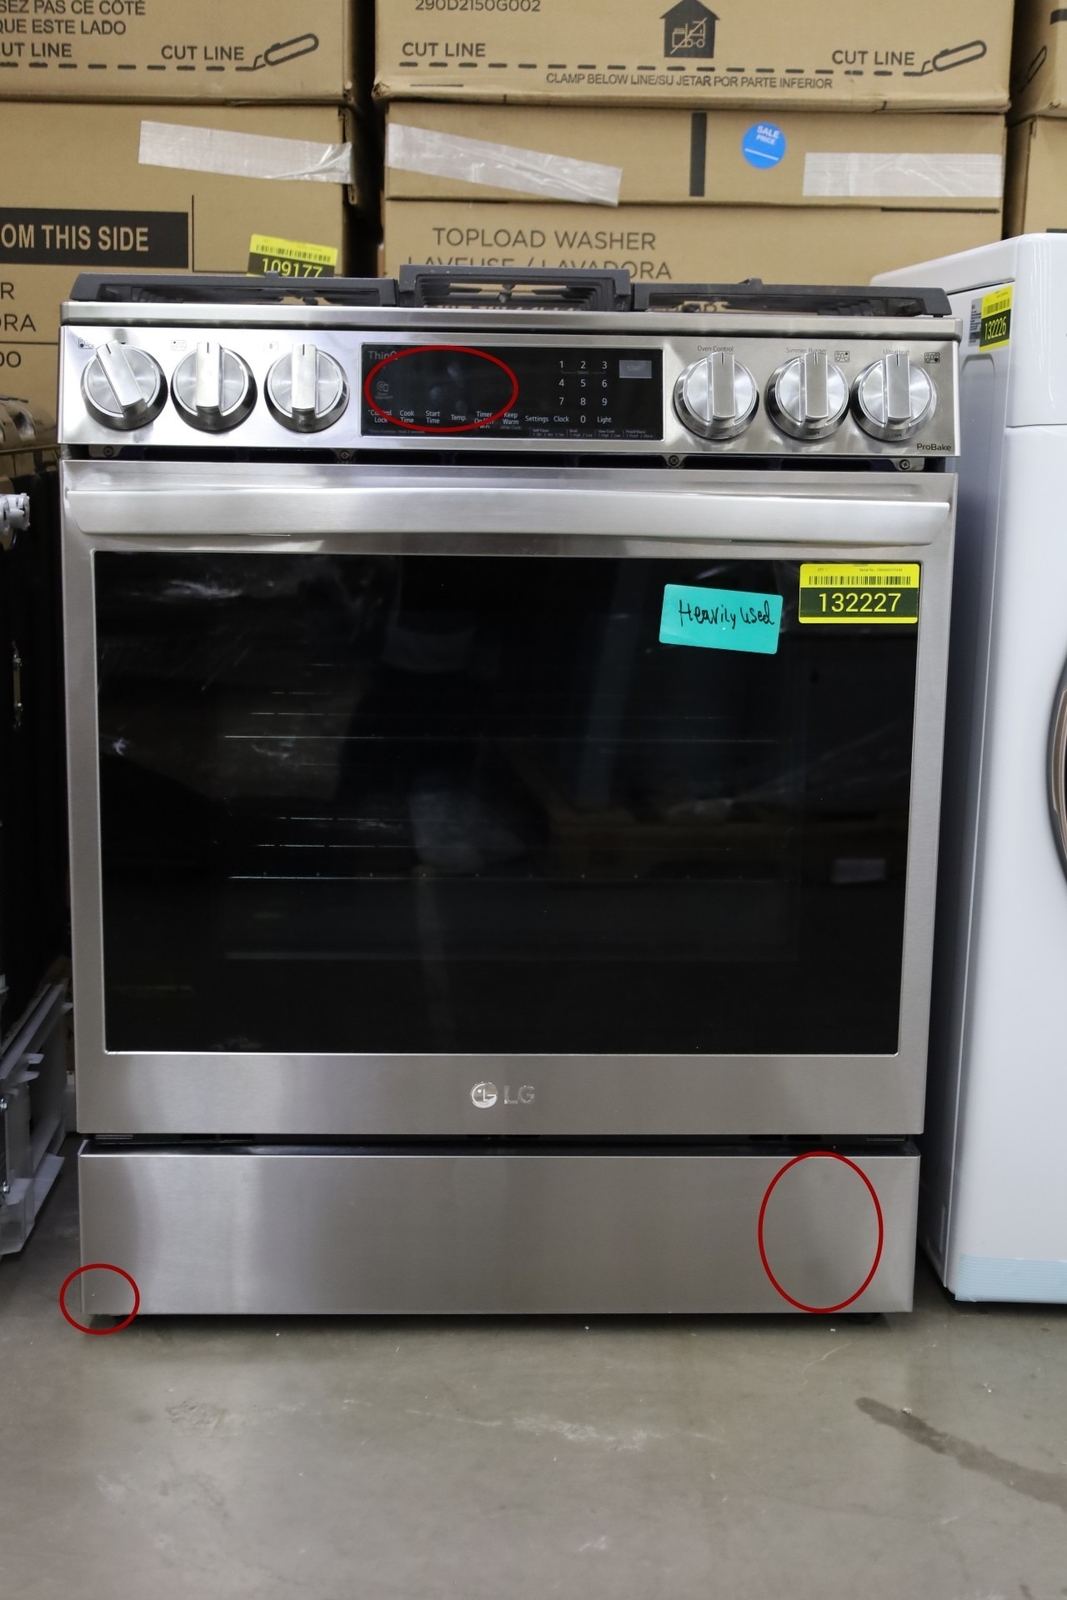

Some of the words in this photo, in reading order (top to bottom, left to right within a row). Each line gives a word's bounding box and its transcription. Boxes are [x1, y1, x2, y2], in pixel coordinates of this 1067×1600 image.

[34, 0, 66, 14] PAS
[71, 0, 94, 15] CE
[0, 19, 27, 34] UE
[32, 20, 75, 34] ESTE
[81, 20, 126, 35] LADO
[0, 42, 25, 57] UT
[31, 43, 72, 58] LINE
[161, 45, 197, 60] CUT
[204, 46, 244, 61] LINE
[402, 42, 438, 57] CUT
[445, 43, 486, 57] LINE
[832, 50, 868, 65] CUT
[874, 51, 915, 66] LINE
[546, 73, 585, 84] CLAMP
[587, 73, 628, 85] BELOW
[630, 75, 673, 86] LINE/SU
[676, 75, 711, 87] JETAR
[713, 76, 738, 87] POR
[741, 76, 777, 88] PARTE
[780, 77, 833, 89] INFERIOR
[756, 125, 780, 139] SALE
[1, 223, 35, 249] OM
[41, 225, 91, 250] THIS
[98, 226, 149, 252] SIDE
[432, 227, 546, 248] TOPLOAD
[554, 231, 656, 250] WASHER
[262, 258, 323, 278] 109177
[0, 282, 15, 300] R
[0, 313, 37, 332] RA
[985, 316, 1007, 340] 132226
[559, 360, 564, 369] 1
[580, 360, 586, 369] 2
[602, 361, 608, 370] 3
[558, 379, 565, 387] 4
[580, 379, 586, 388] 5
[602, 379, 608, 388] 6
[559, 397, 565, 405] 7
[580, 397, 586, 406] 8
[602, 398, 608, 406] 9
[503, 412, 518, 420] Keep
[525, 415, 549, 424] Settings
[580, 415, 586, 424] 0
[597, 416, 612, 424] Light
[916, 443, 952, 451] ProBake
[819, 592, 902, 612] 132227
[679, 599, 736, 630] Heavily
[503, 1085, 535, 1104] LG
